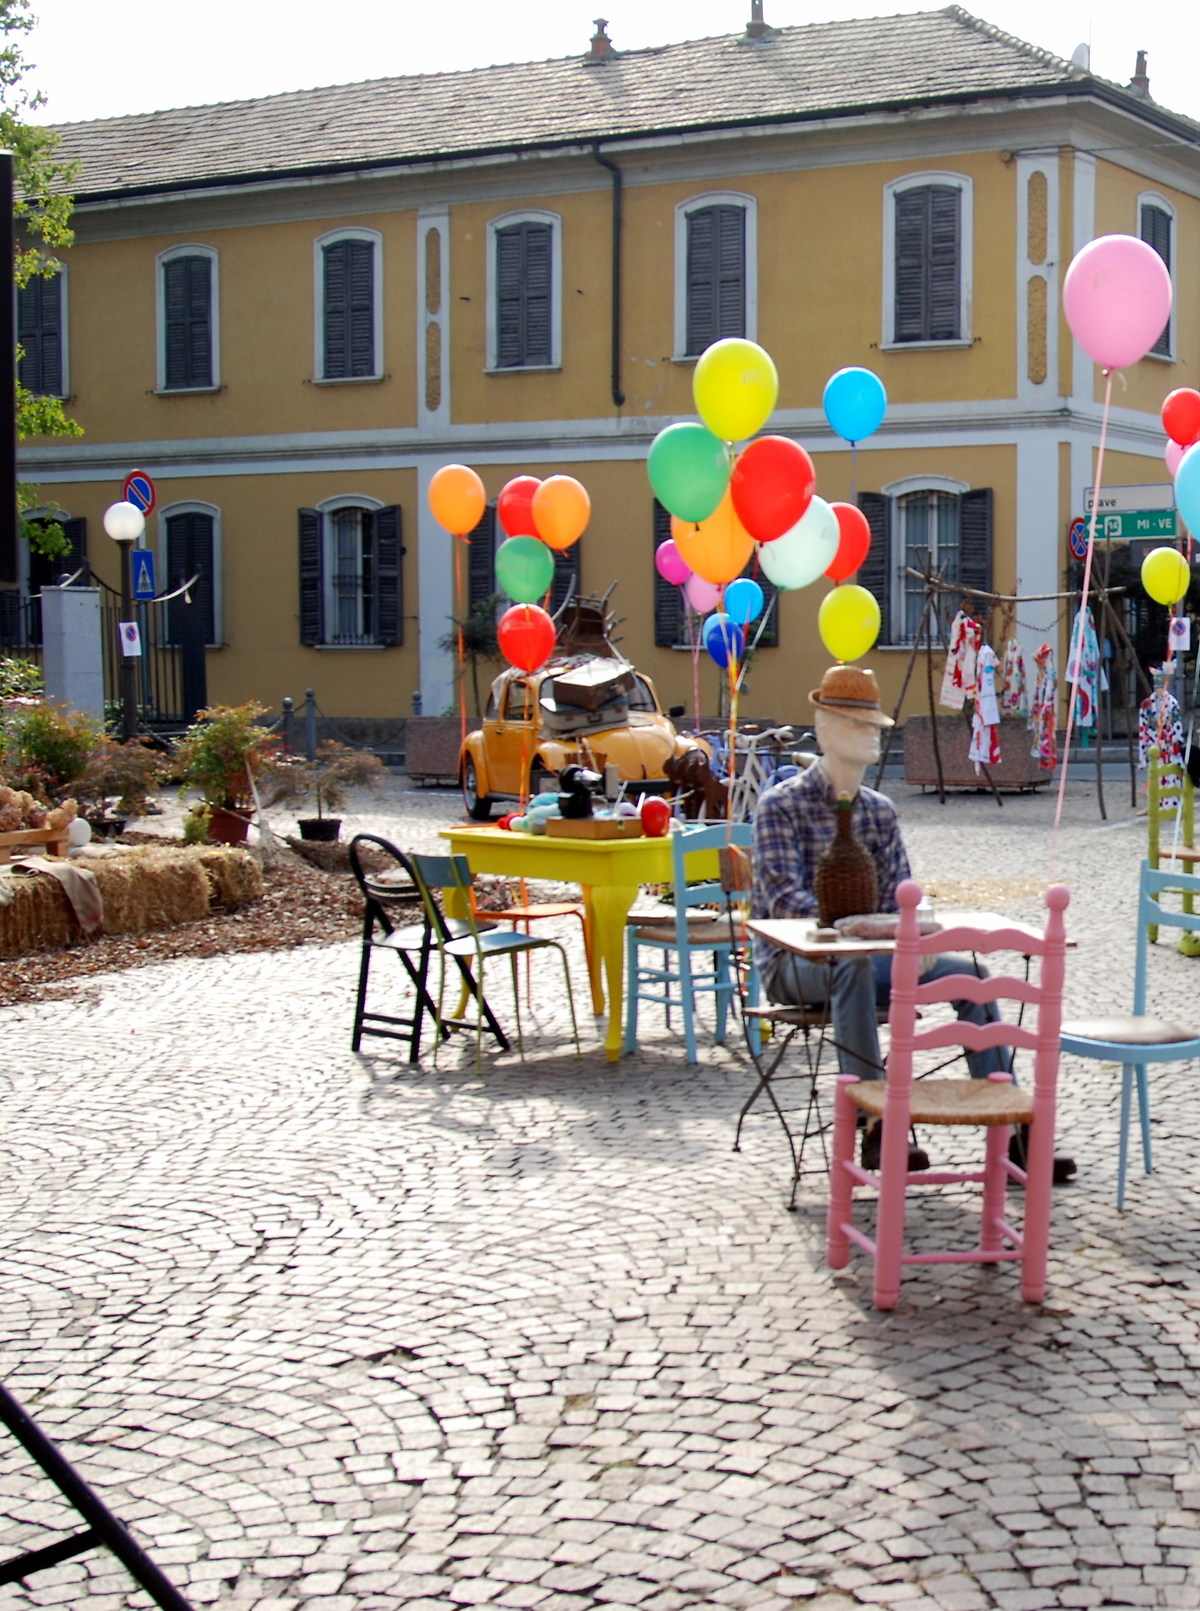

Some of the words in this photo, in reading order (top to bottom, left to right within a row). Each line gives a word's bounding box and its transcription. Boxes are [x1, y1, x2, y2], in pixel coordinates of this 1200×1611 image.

[1088, 499, 1117, 509] pave
[1137, 519, 1150, 530] MI
[1158, 518, 1173, 529] VE
